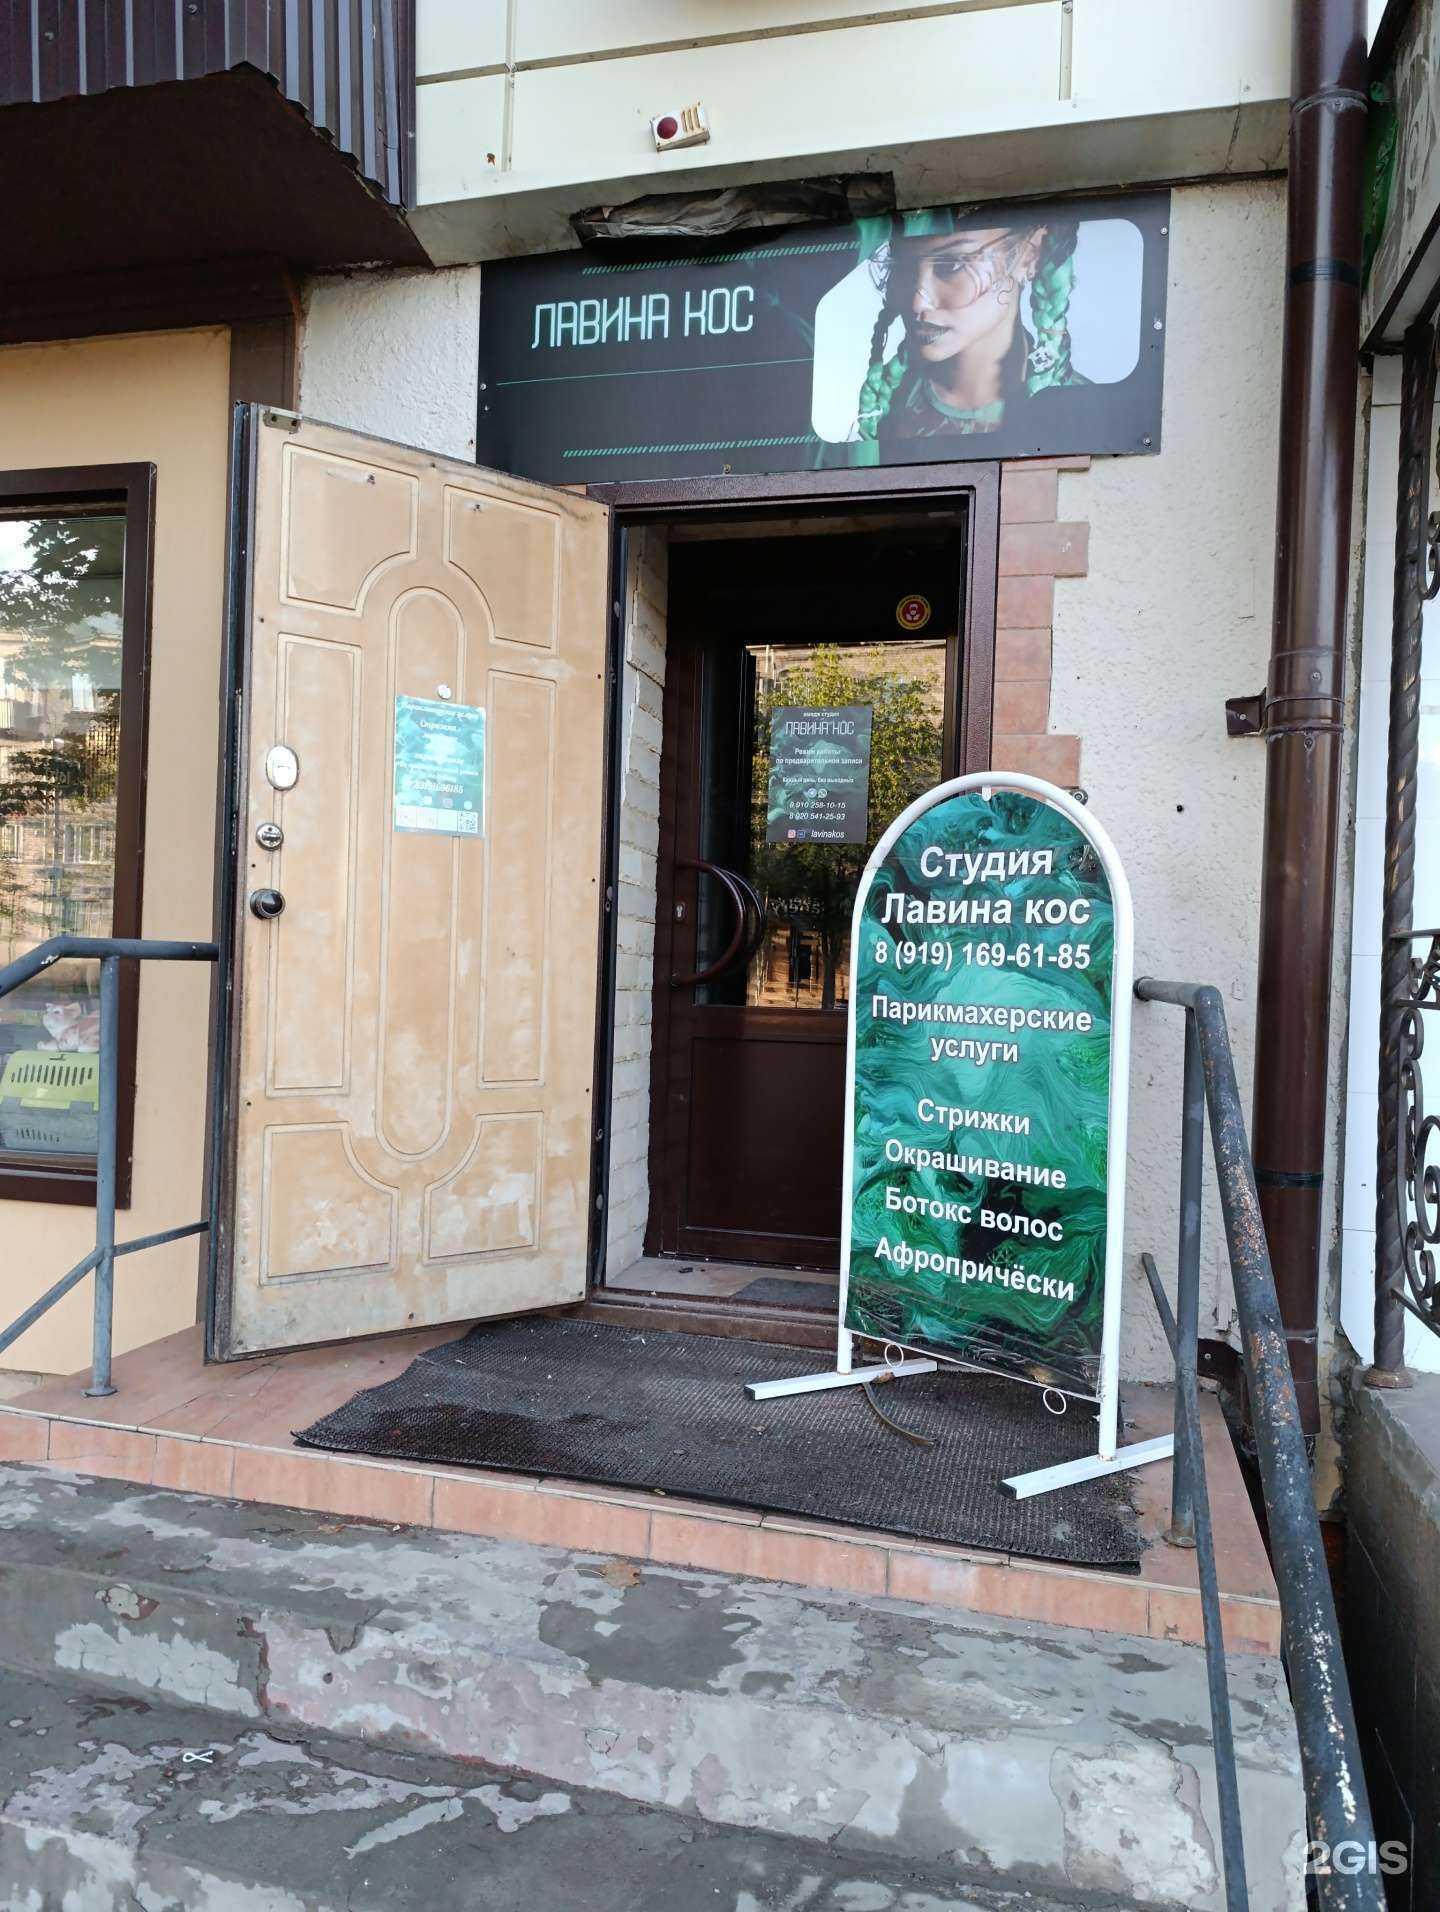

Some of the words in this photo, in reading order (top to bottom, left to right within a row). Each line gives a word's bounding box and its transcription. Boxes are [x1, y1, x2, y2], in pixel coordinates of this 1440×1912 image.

[531, 293, 669, 349] ЛАВИНА
[684, 285, 754, 337] КОС
[811, 829, 845, 839] lavinakos
[920, 846, 1053, 885] Студия
[880, 892, 1012, 925] Лавина
[1025, 897, 1091, 925] кос
[874, 940, 888, 964] 8
[895, 940, 953, 971] (919)
[962, 942, 1091, 970] 169-61-85
[871, 995, 1093, 1033] Парикмахерские
[930, 1036, 1019, 1066] услуги
[917, 1098, 1030, 1135] Стрижки
[884, 1138, 1067, 1190] Окрашивание
[885, 1186, 972, 1224] Ботокс
[980, 1208, 1064, 1242] волос
[874, 1236, 1075, 1302] Афропричёски
